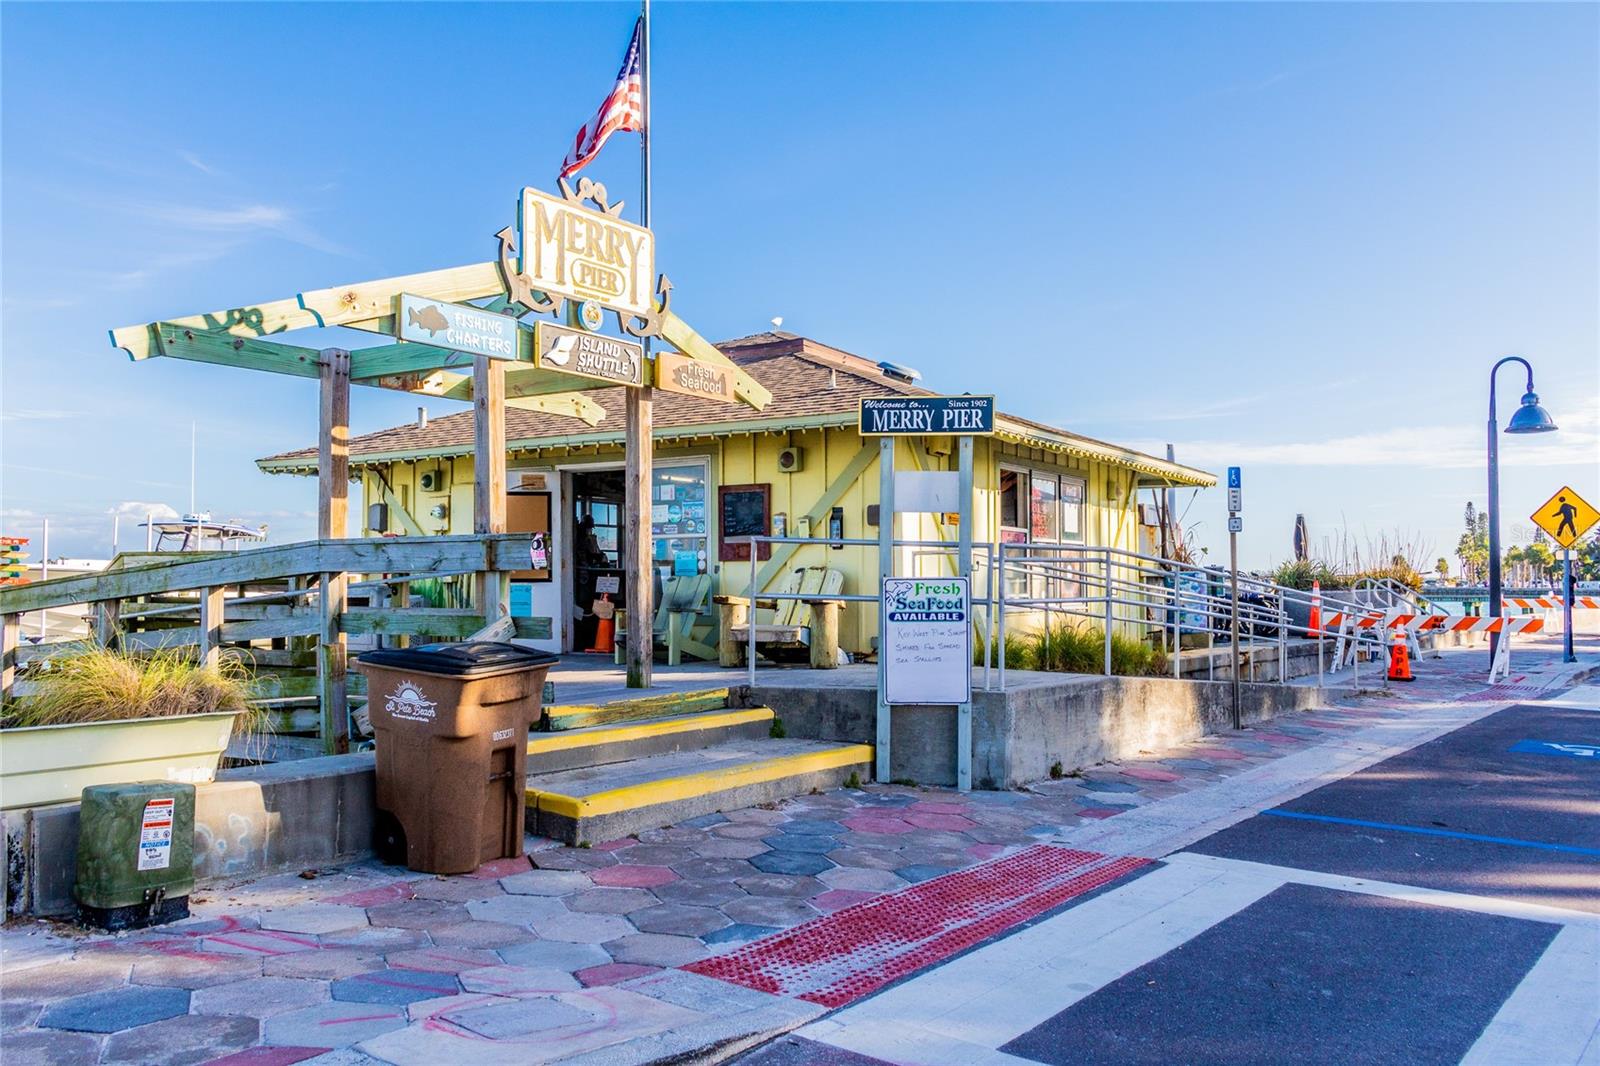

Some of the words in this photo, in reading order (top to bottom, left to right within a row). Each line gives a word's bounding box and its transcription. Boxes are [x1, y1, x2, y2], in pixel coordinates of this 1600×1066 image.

[532, 201, 645, 305] MERRY
[580, 263, 618, 292] PIER
[454, 312, 502, 335] FISHING
[447, 328, 512, 354] CHARTERS
[579, 336, 620, 357] ISLAND
[578, 352, 628, 375] SHUTTLE
[688, 361, 716, 380] Fresh
[681, 373, 721, 394] Seafood
[864, 400, 906, 408] Welcome
[948, 400, 969, 408] Since
[872, 409, 934, 431] MERRY
[942, 408, 984, 429] PIER
[914, 582, 961, 596] Fresh
[894, 612, 960, 621] AVAILABLE
[412, 704, 436, 717] Beach
